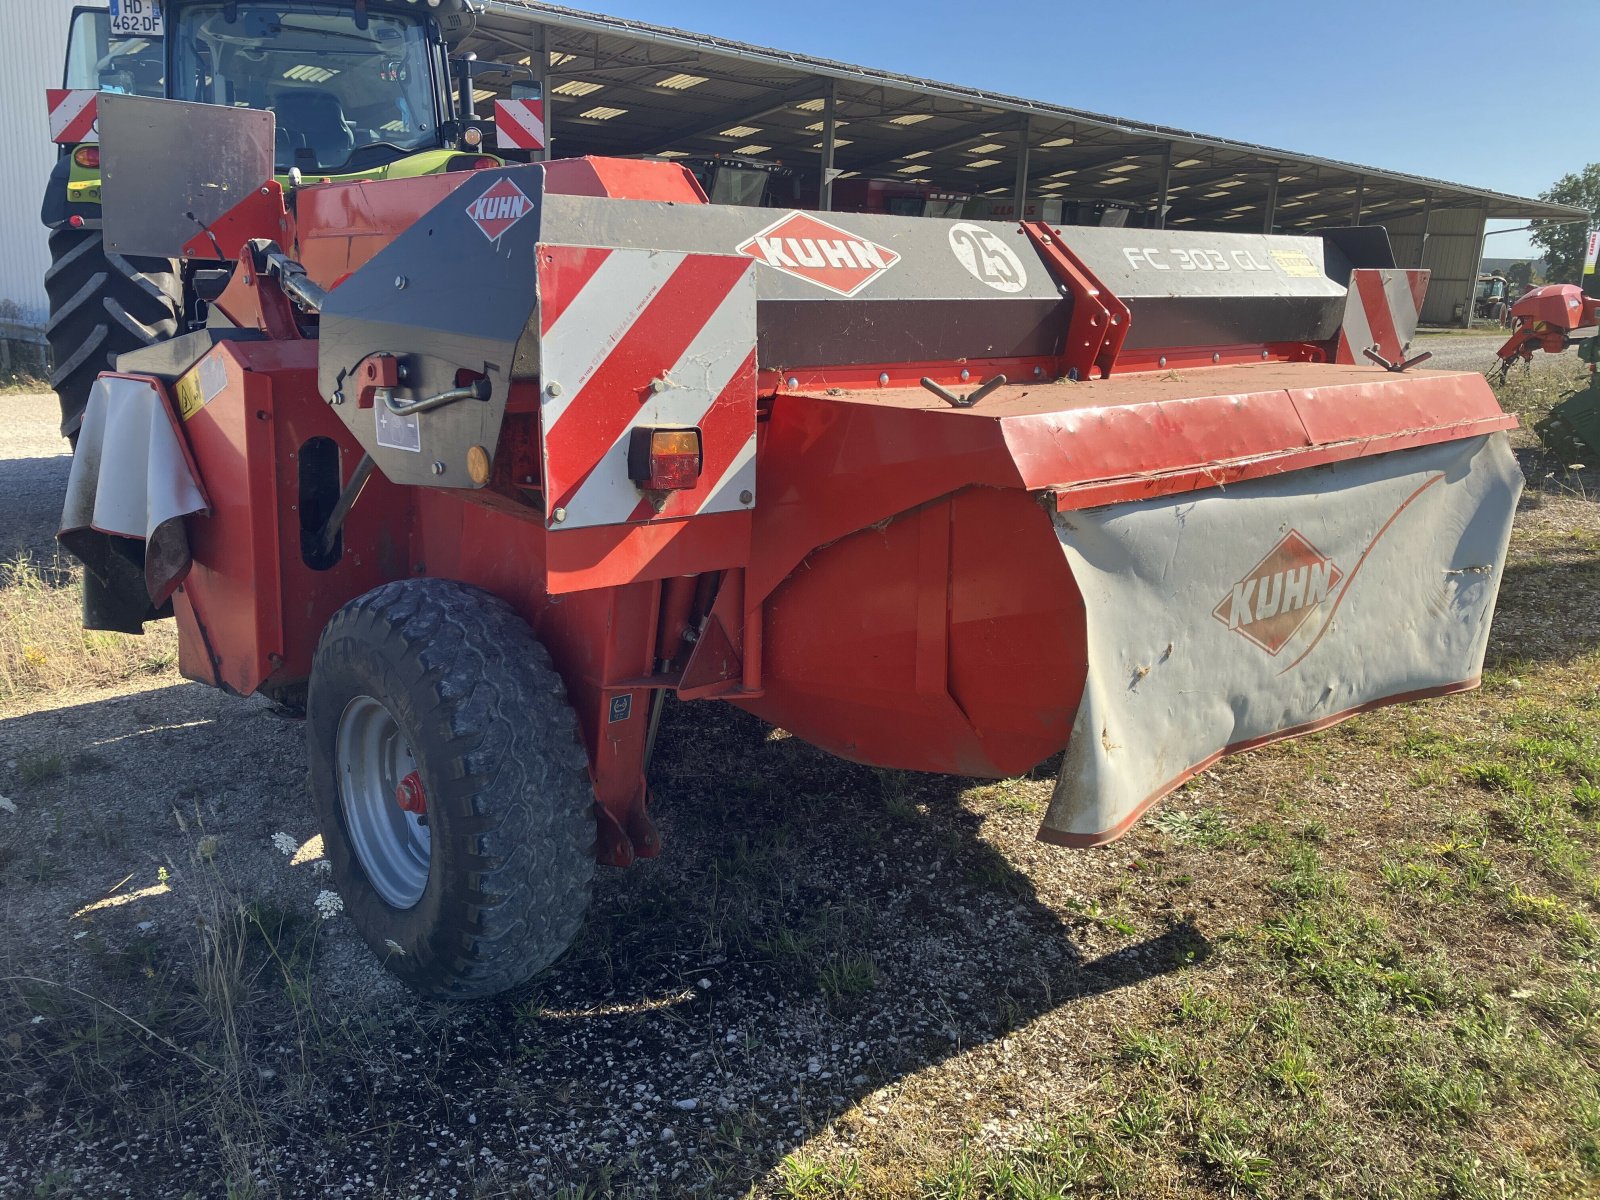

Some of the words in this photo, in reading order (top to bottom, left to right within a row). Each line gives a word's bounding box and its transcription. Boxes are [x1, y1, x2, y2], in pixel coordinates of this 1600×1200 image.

[113, 16, 160, 31] 462-DF
[474, 195, 525, 220] KUHN
[991, 205, 1036, 215] CLAS
[754, 235, 888, 270] KUHN
[953, 229, 1020, 284] 25
[1122, 247, 1171, 270] FC
[1169, 248, 1231, 271] 303
[1230, 250, 1273, 271] GL
[1228, 558, 1332, 631] KUHN
